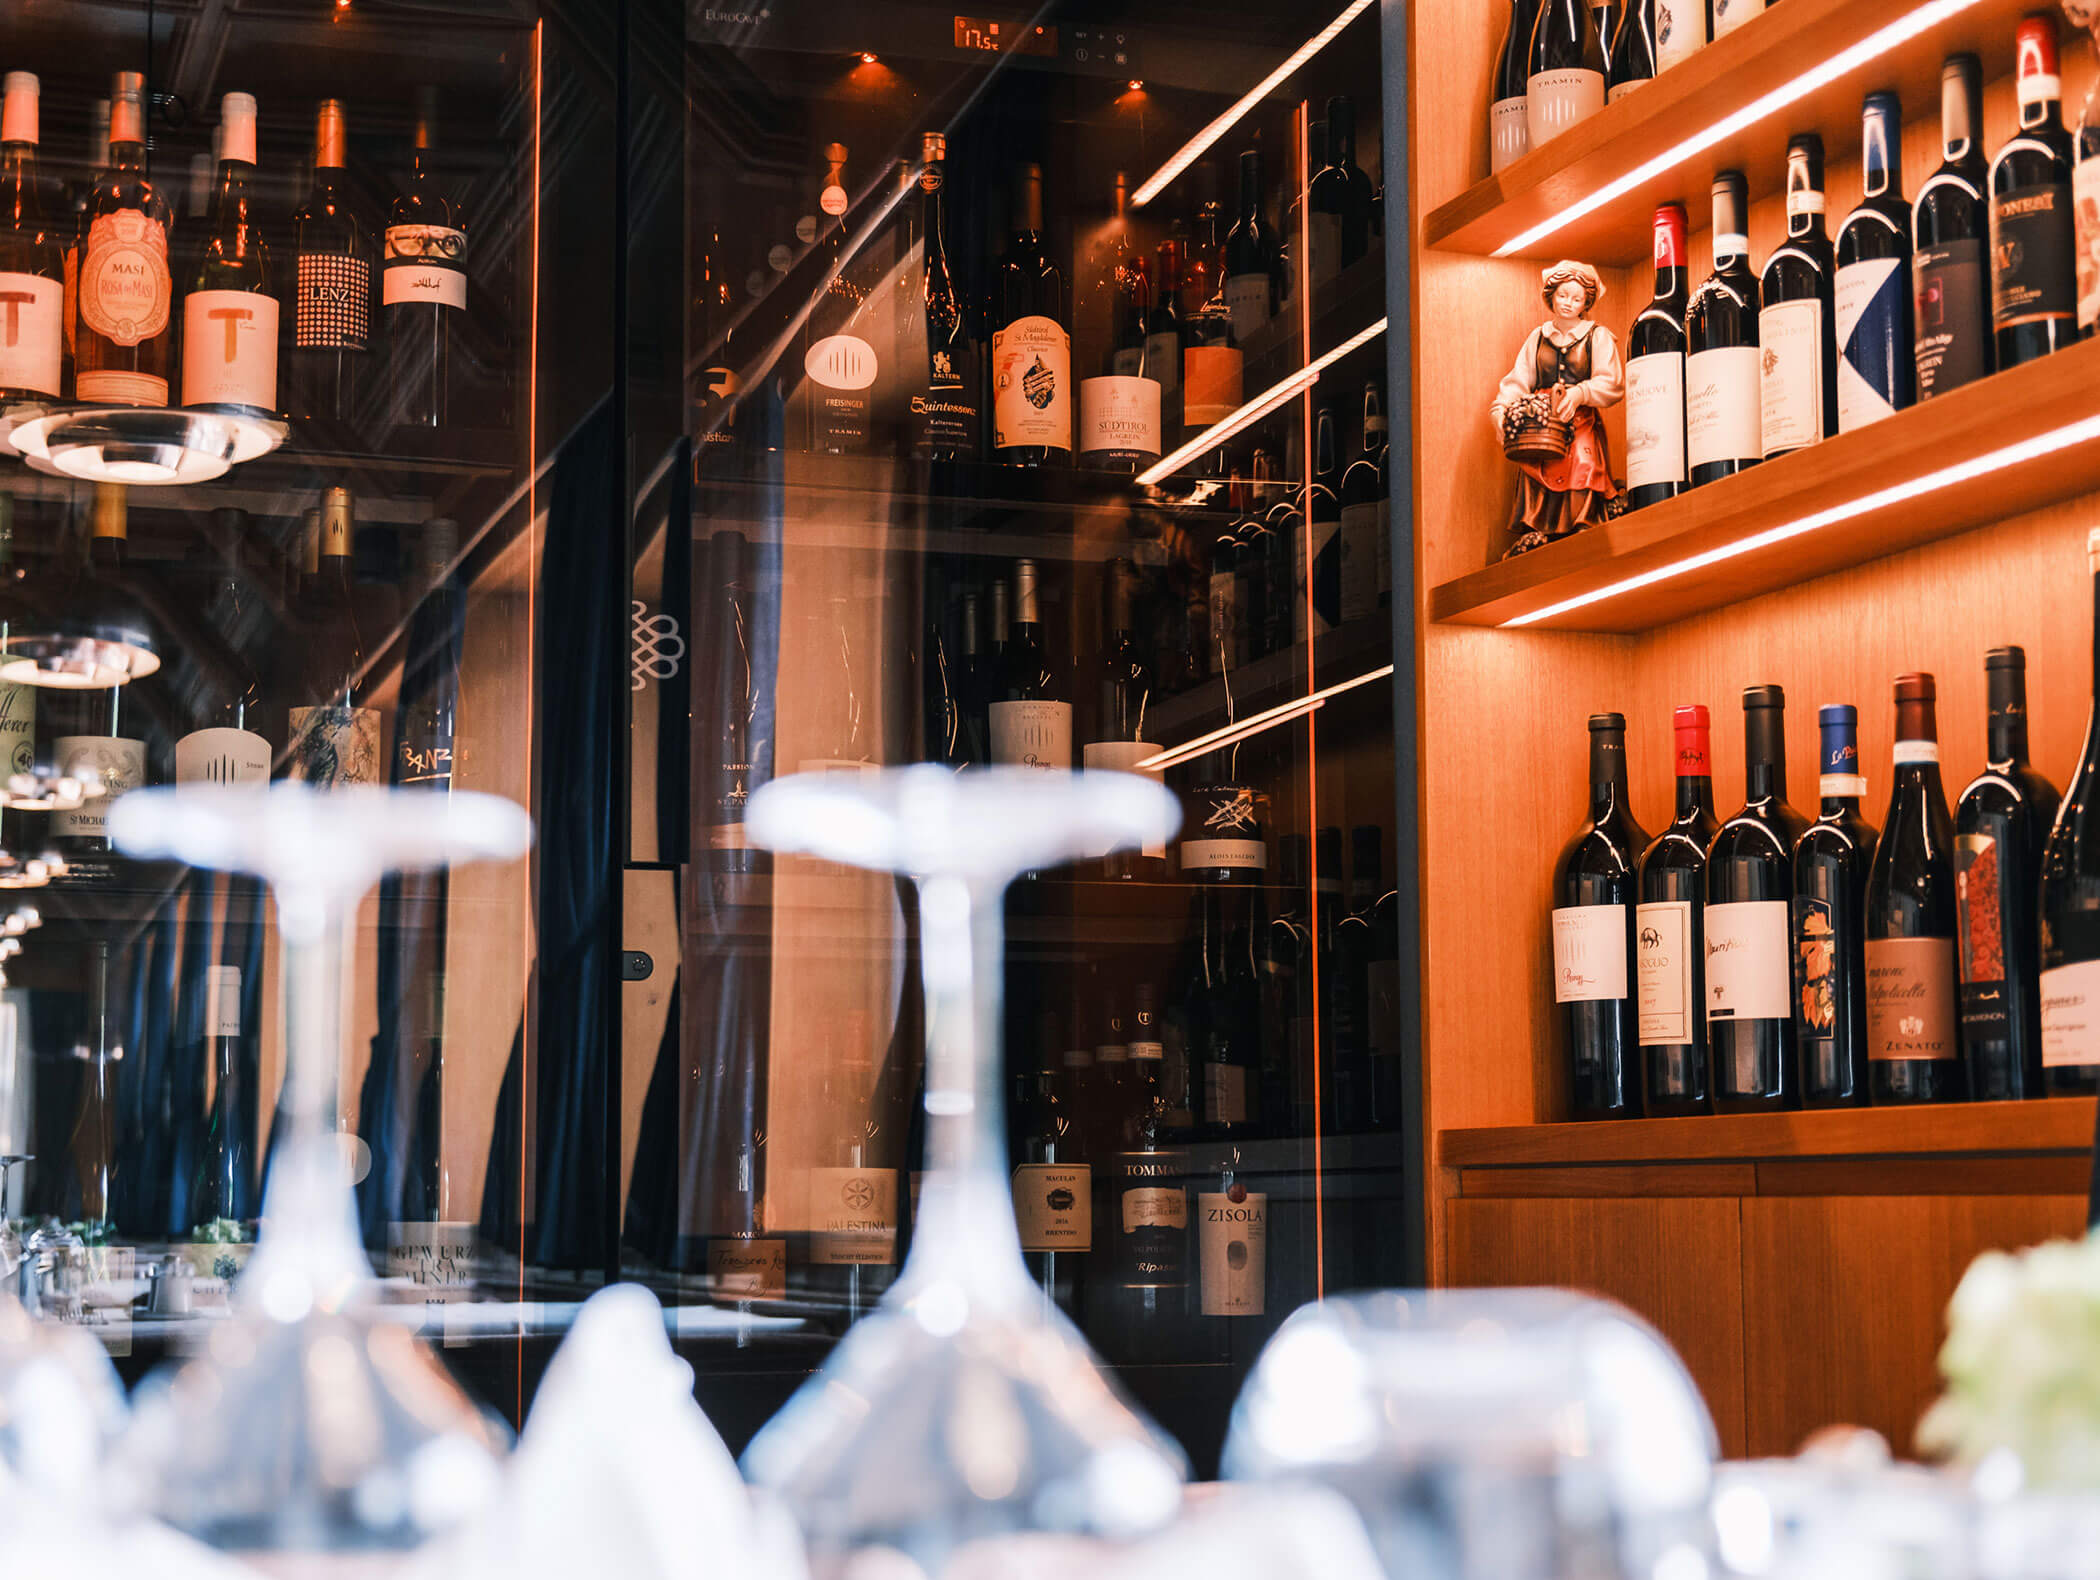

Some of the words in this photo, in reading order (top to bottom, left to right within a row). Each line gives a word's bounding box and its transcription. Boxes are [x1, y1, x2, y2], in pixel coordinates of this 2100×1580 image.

[1537, 77, 1583, 88] TRAMIN
[112, 263, 144, 275] MASI
[310, 287, 350, 302] LENZ
[208, 308, 253, 364] T
[825, 398, 864, 409] FREISINGER
[1886, 1040, 1942, 1052] ZENATO
[1208, 1208, 1263, 1222] ZISOLA
